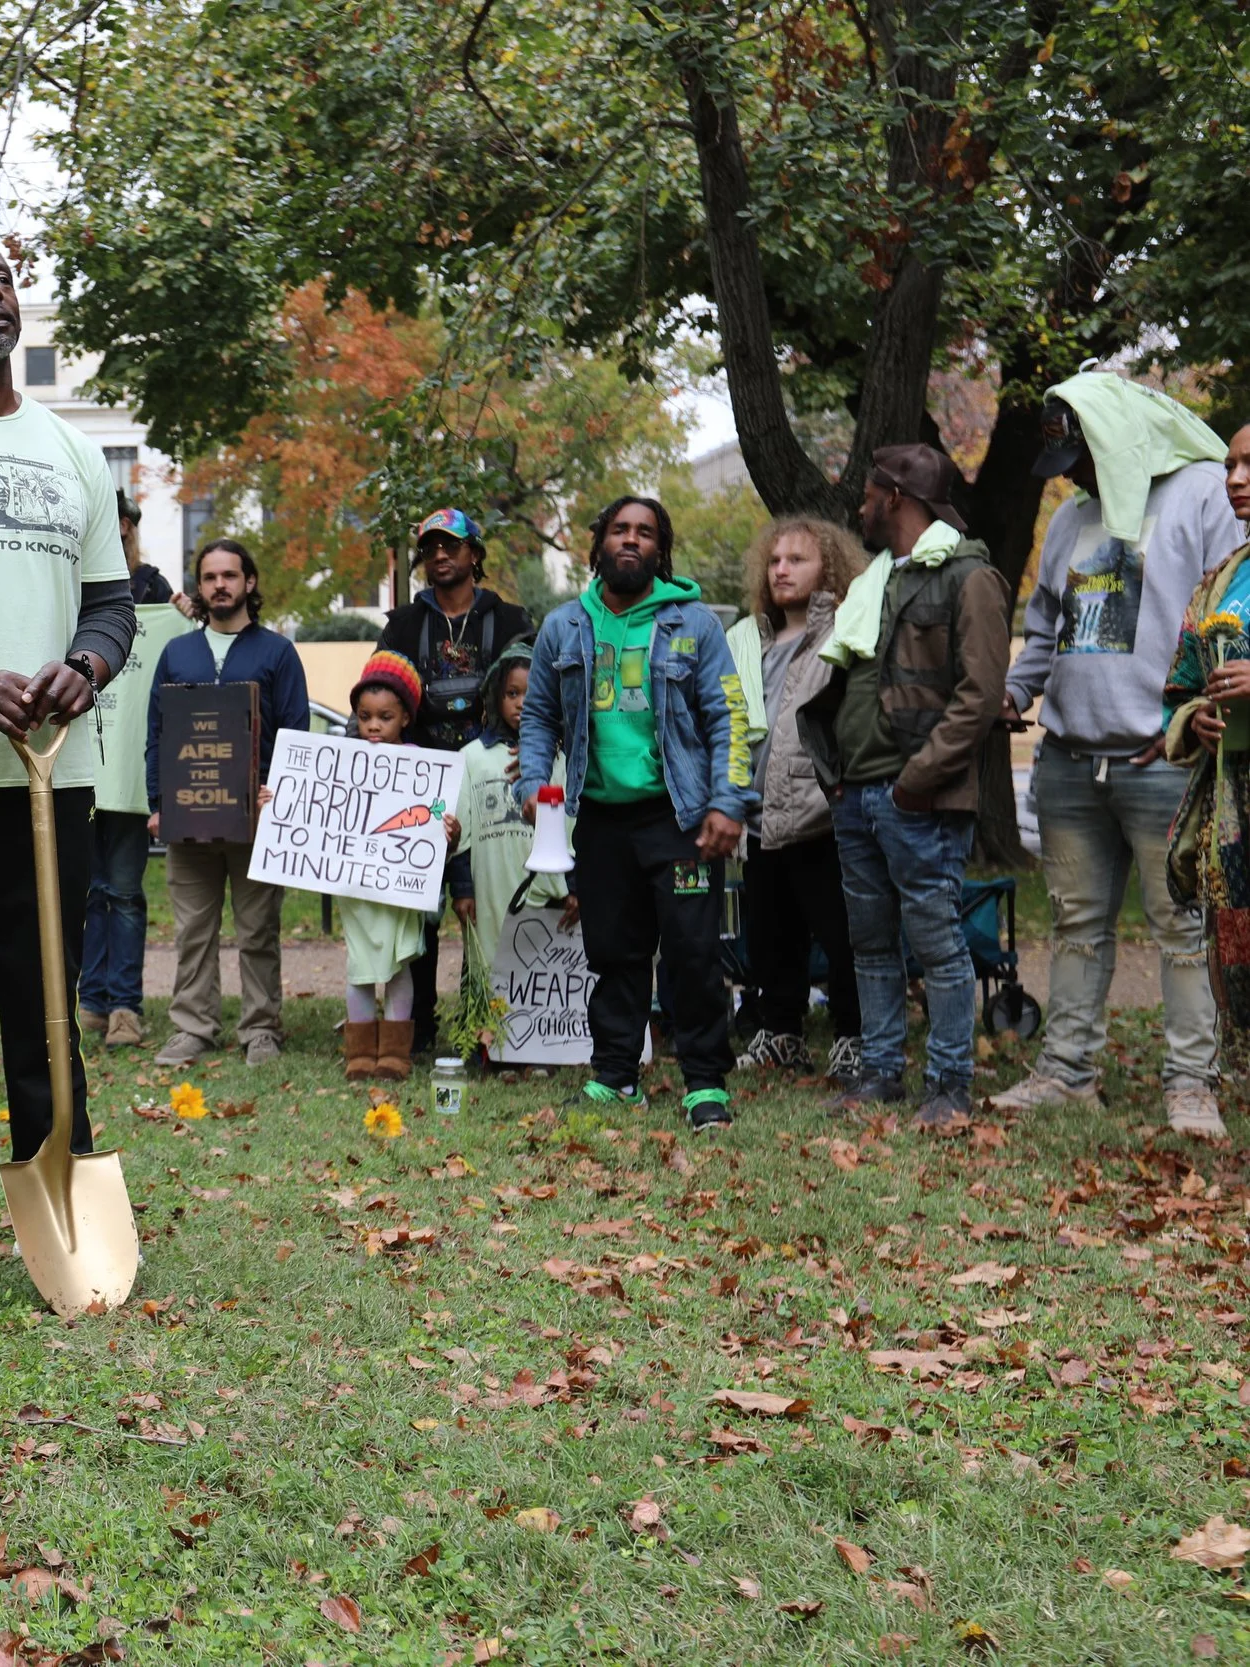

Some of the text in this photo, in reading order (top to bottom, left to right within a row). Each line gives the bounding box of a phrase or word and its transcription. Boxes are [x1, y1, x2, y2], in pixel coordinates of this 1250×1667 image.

[193, 720, 218, 731] WE
[178, 742, 233, 760] ARE
[189, 769, 219, 780] THE
[286, 745, 453, 798] THE CLOSEST
[176, 788, 238, 805] SOIL
[272, 775, 380, 836] CARROT
[271, 821, 436, 870] TO ME IS 30
[262, 847, 427, 891] MINUTES AWAY
[547, 947, 589, 974] my
[538, 1017, 592, 1038] CHOICE
